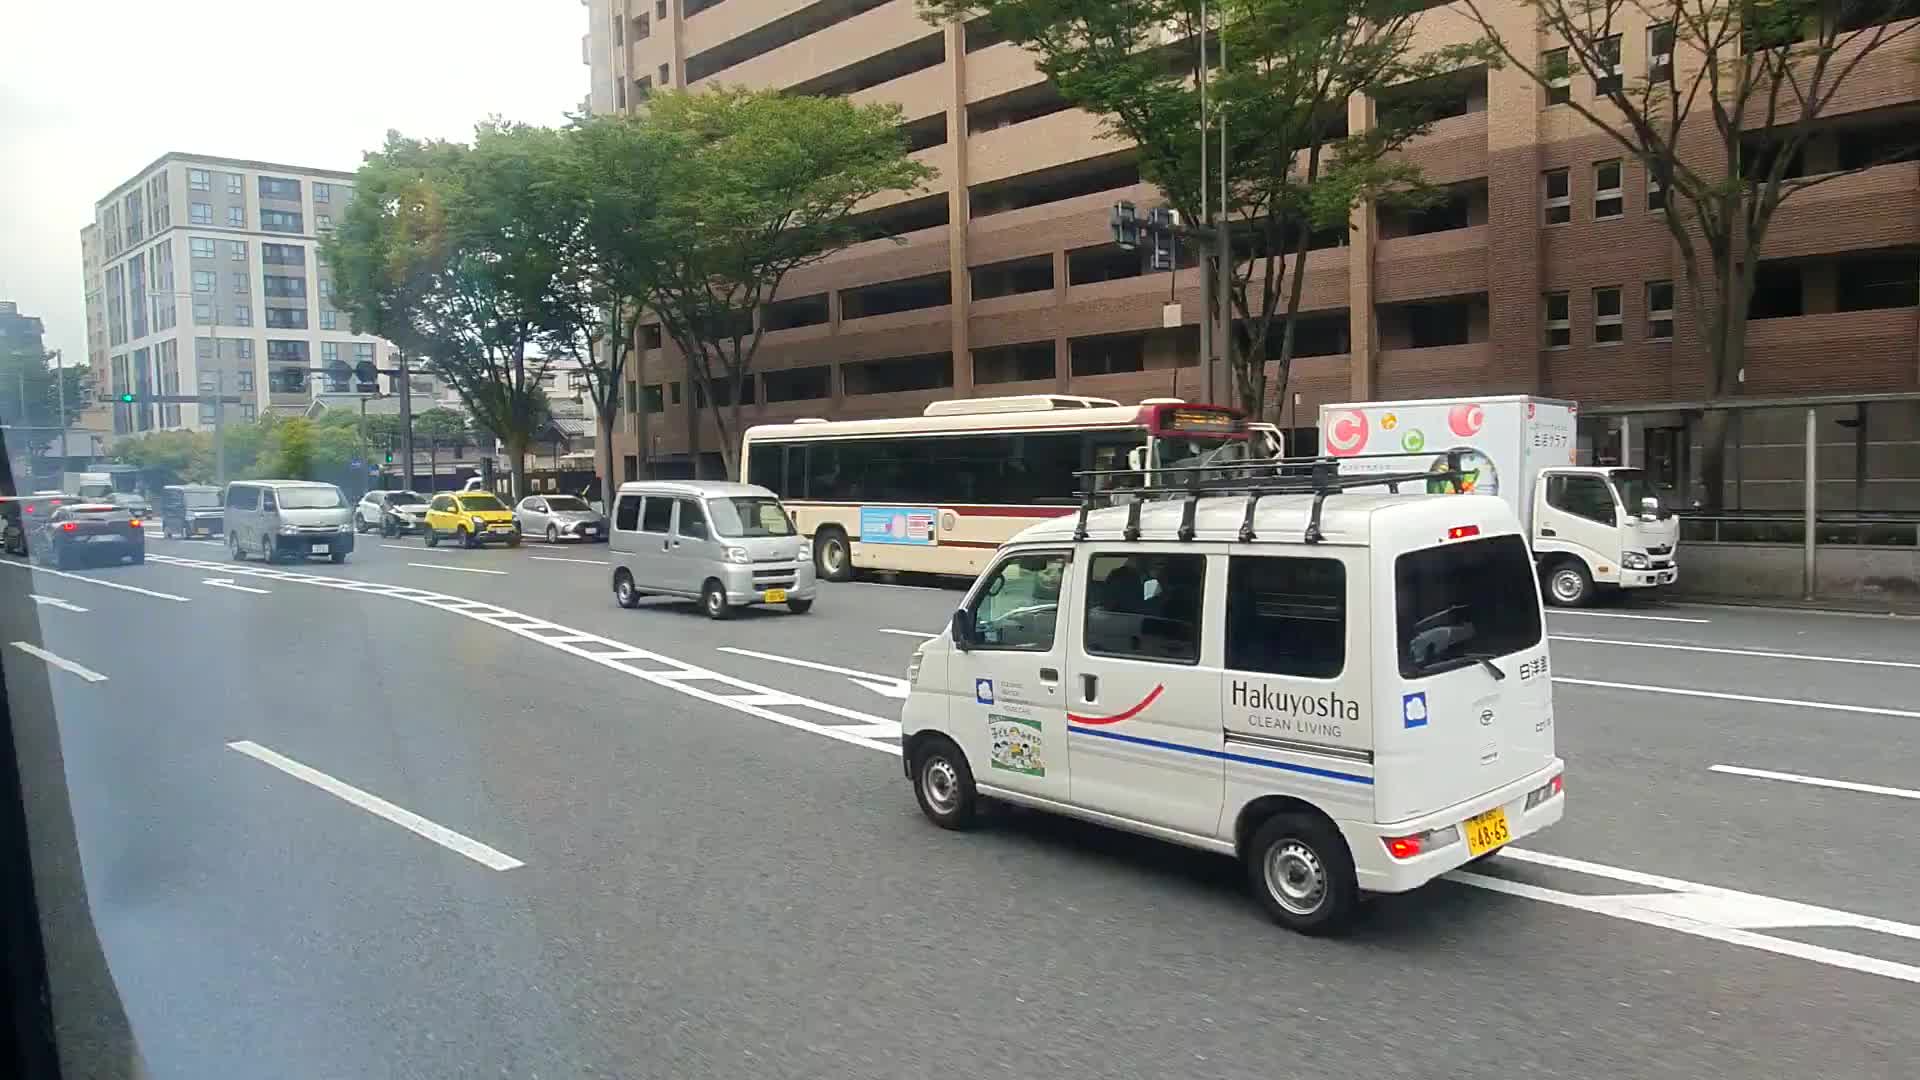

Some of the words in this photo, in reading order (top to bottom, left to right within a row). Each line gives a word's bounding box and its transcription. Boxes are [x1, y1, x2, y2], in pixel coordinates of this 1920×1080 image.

[1232, 680, 1359, 721] Hakuyosha
[1248, 714, 1291, 731] CLEAN
[1296, 719, 1342, 738] LIVING
